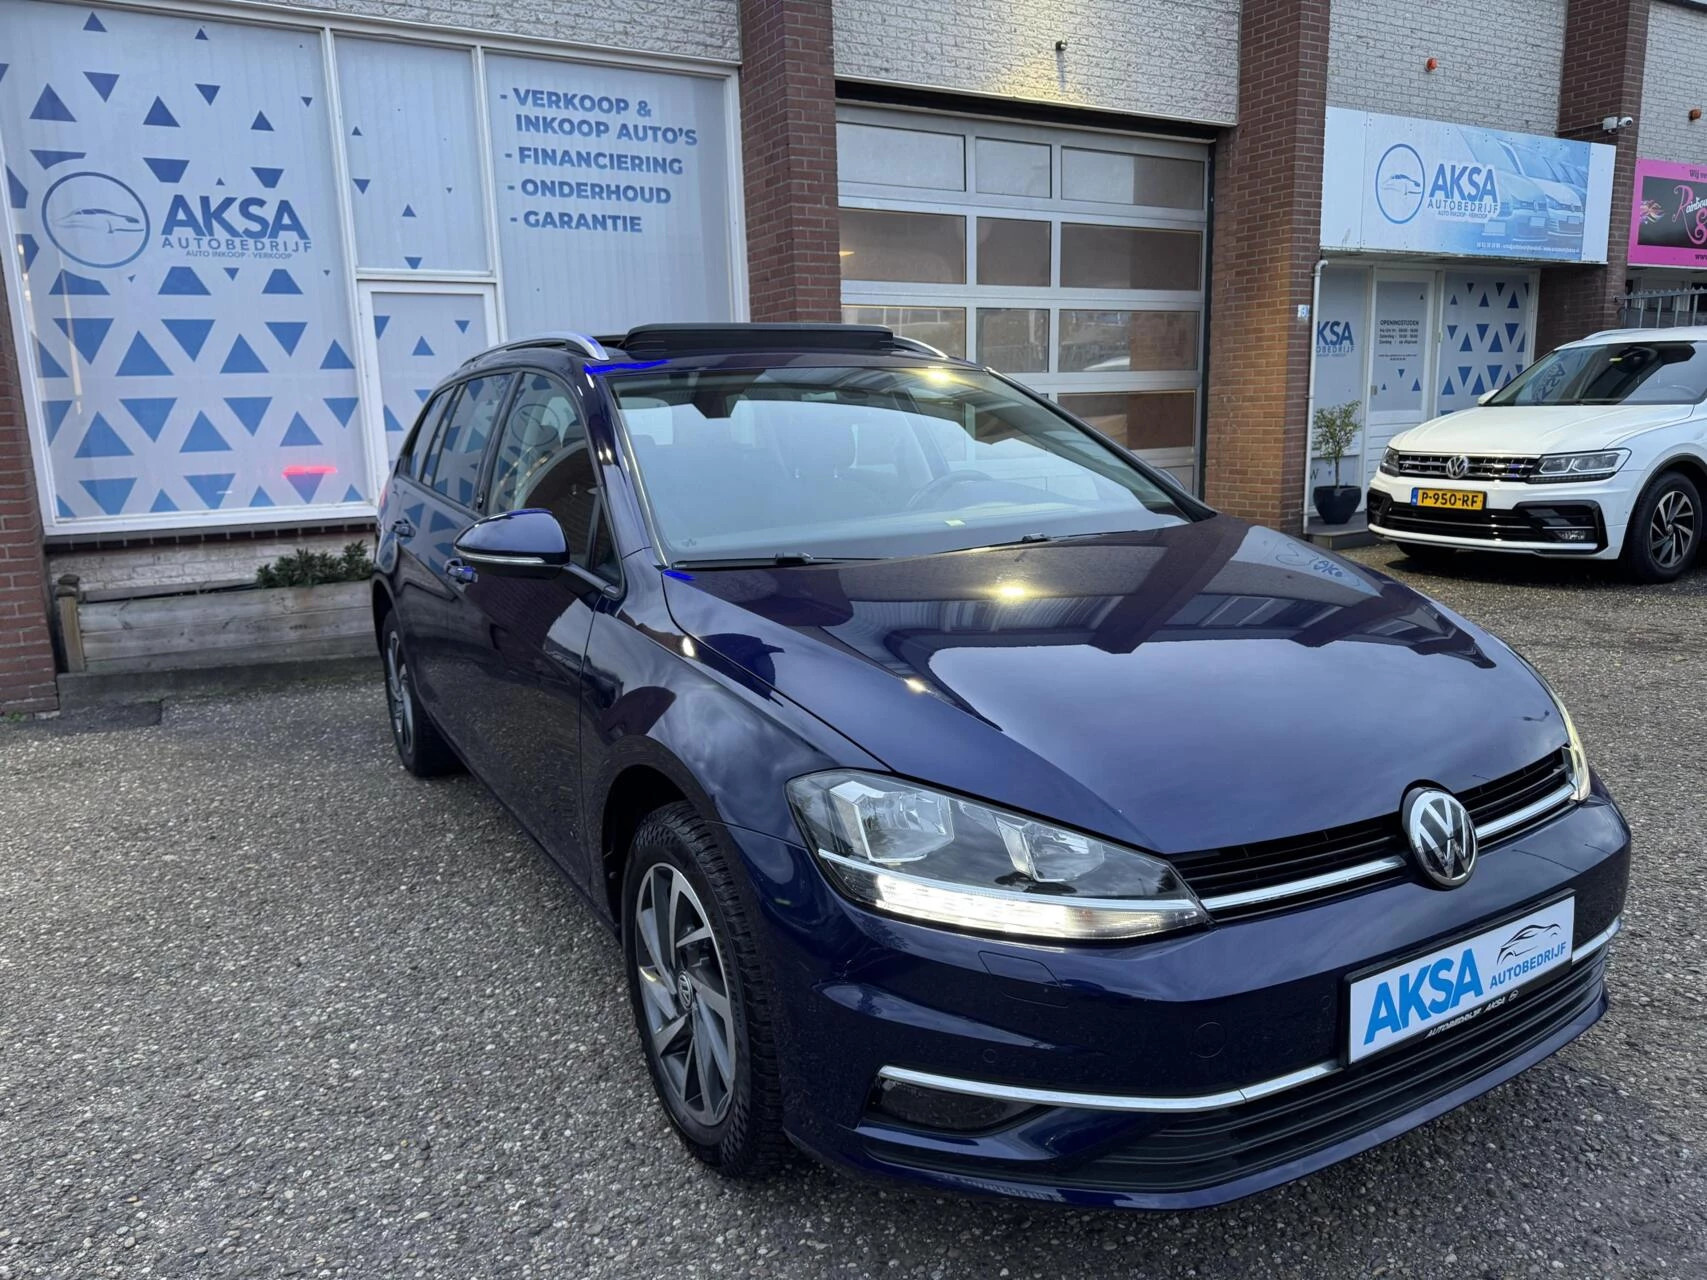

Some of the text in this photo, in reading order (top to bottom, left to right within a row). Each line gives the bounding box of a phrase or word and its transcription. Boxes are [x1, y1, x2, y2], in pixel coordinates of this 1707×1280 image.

[512, 87, 630, 115] VERKOOP
[636, 100, 652, 118] &
[515, 113, 610, 138] INKOOP
[518, 146, 683, 175] FINANCIERING
[520, 178, 672, 204] ONDERHOUD
[1428, 163, 1498, 203] AKSA
[160, 194, 311, 240] AKSA
[1427, 199, 1499, 214] AUTOBEDRIJF
[523, 210, 643, 233] GARANTIE
[161, 237, 312, 253] AUTOBEDRIJF
[186, 249, 210, 258] AUTO
[212, 250, 246, 259] INKOOP
[252, 251, 293, 260] VERKOOP
[1316, 321, 1354, 346] KSA
[1421, 491, 1479, 508] P-950-RF
[1489, 941, 1567, 989] AUTOBEDRIJF
[1363, 948, 1484, 1045] AKSA
